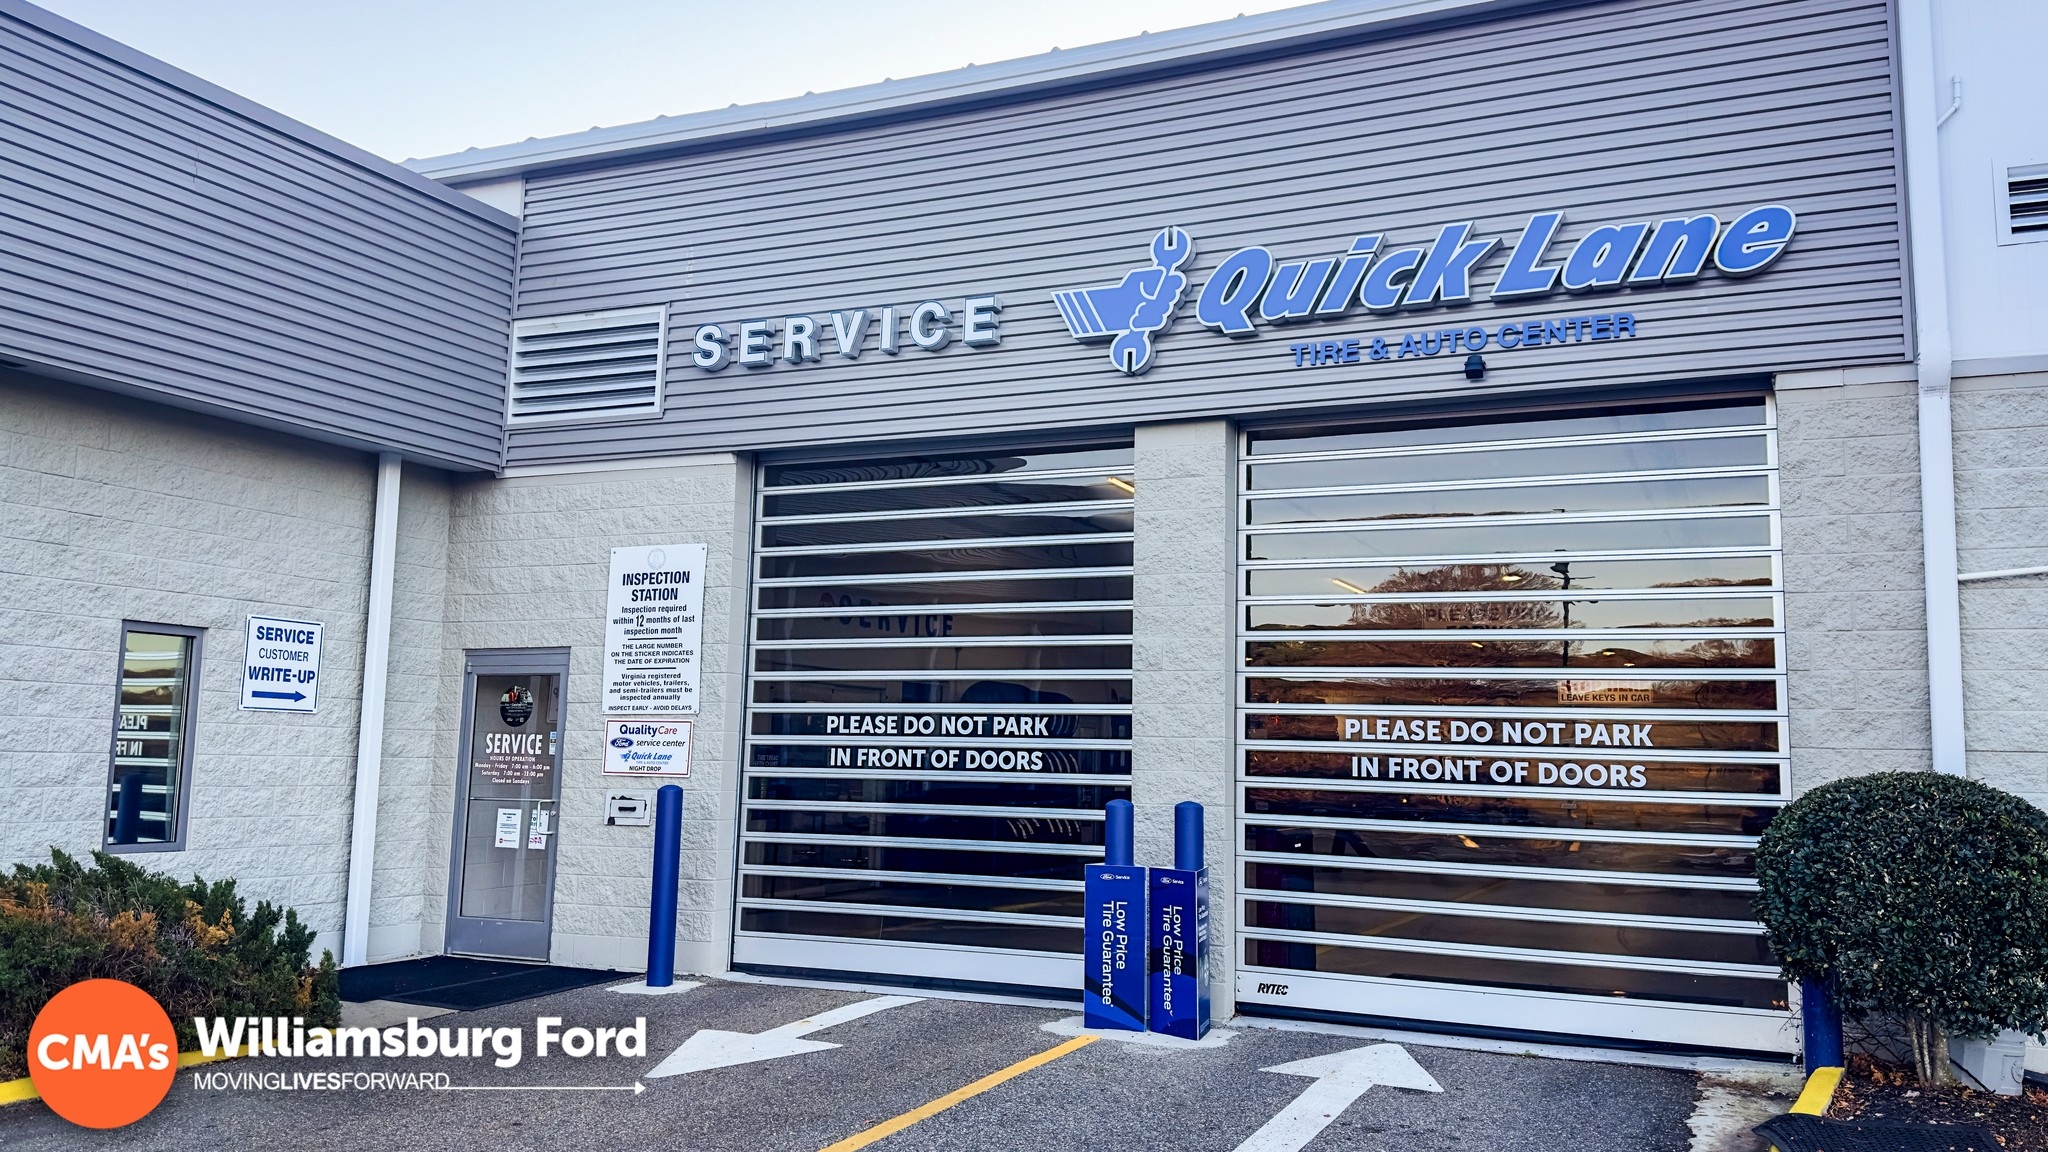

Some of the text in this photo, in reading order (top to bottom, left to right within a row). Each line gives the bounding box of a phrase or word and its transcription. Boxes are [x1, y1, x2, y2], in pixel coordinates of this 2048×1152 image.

[1196, 204, 1796, 337] Quick Lane
[692, 295, 1002, 372] SERVICE
[1290, 312, 1636, 366] TIRE & AUTO CENTER
[622, 570, 690, 586] INSPECTION
[631, 588, 678, 602] STATION
[622, 604, 687, 614] Inspection required
[613, 617, 634, 625] within
[636, 614, 644, 627] 12
[646, 616, 671, 624] months
[673, 615, 680, 623] of
[256, 625, 315, 645] SERVICE
[624, 626, 682, 636] inspection month
[258, 647, 309, 662] CUSTOMER
[248, 665, 316, 684] WRITE-UP
[647, 672, 681, 680] registered
[619, 694, 651, 702] inspected
[1561, 693, 1650, 702] LEAVE KEYS IN CAR
[826, 715, 1049, 737] PLEASE DO NOT PARK
[1345, 717, 1654, 747] PLEASE DO NOT PARK
[485, 733, 543, 755] SERVICE
[636, 739, 660, 747] service
[631, 751, 673, 761] Quick Lane
[830, 748, 1043, 771] IN FRONT OF DOORS
[1351, 756, 1647, 788] IN FRONT OF DOORS
[1102, 900, 1114, 928] Tire
[1162, 904, 1172, 932] Tire
[1115, 901, 1128, 970] Low Price
[1172, 906, 1184, 976] Low Price
[1257, 982, 1289, 996] RYTEC
